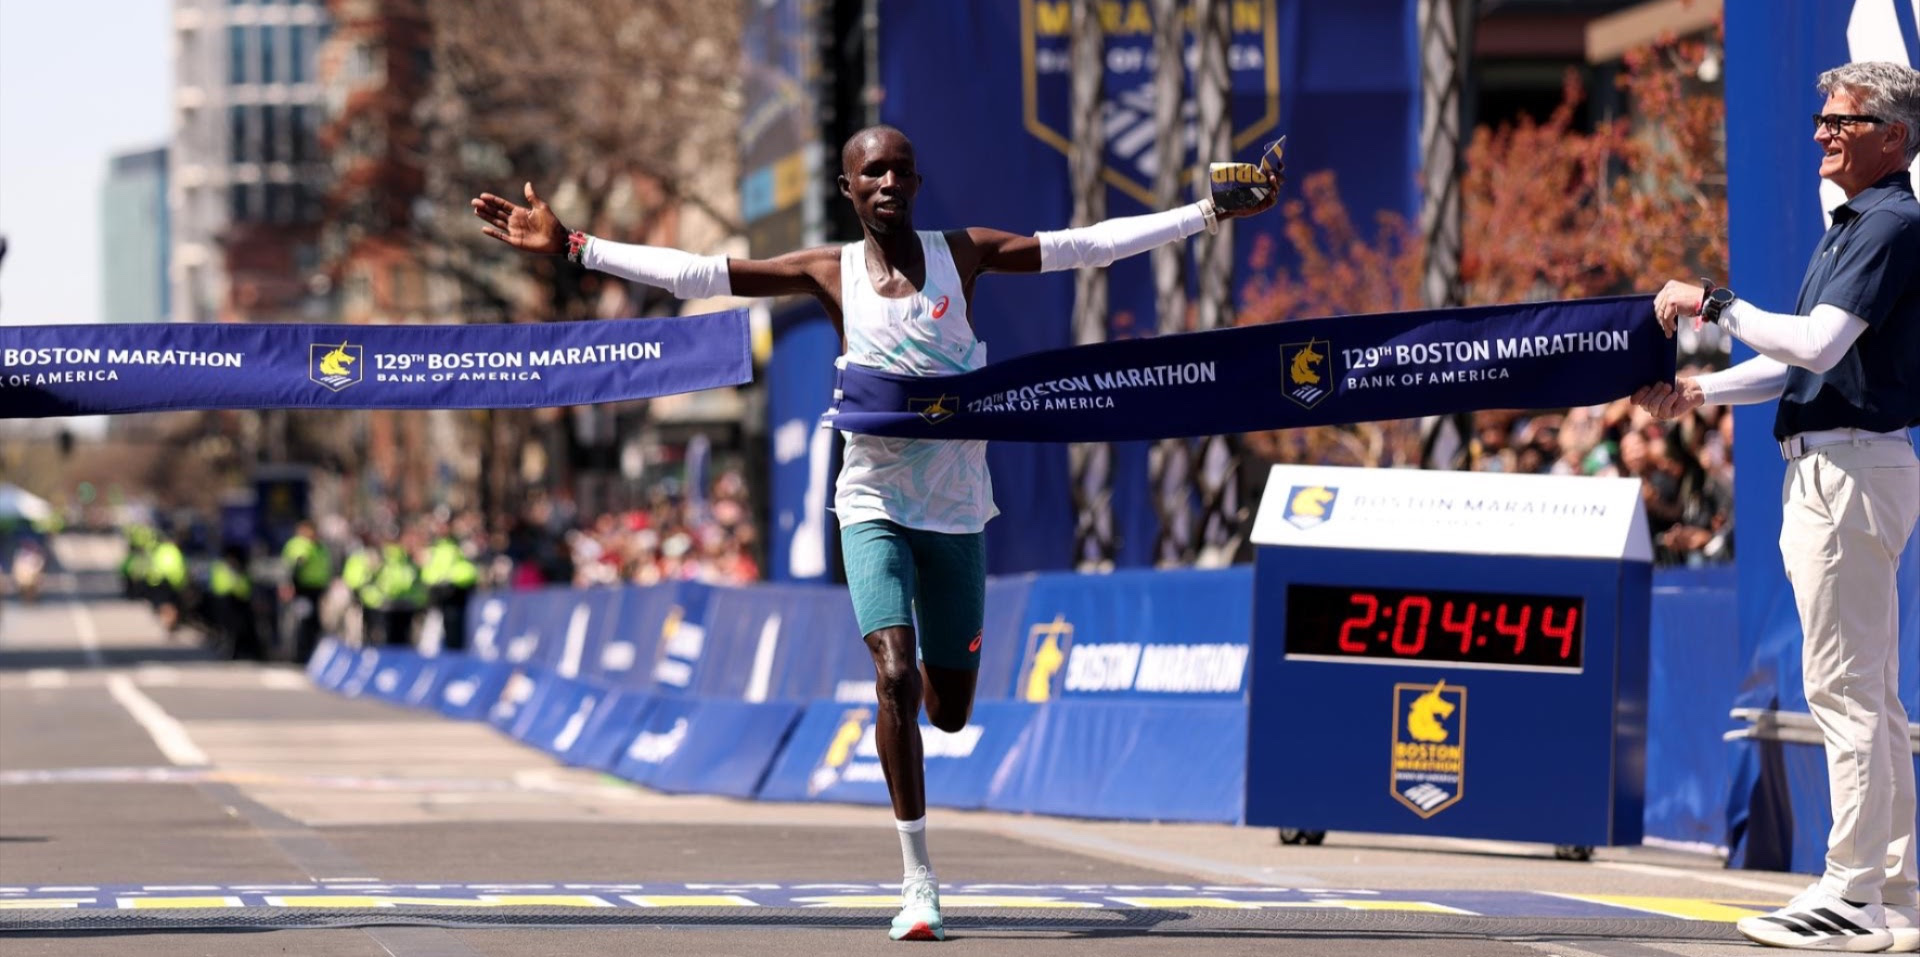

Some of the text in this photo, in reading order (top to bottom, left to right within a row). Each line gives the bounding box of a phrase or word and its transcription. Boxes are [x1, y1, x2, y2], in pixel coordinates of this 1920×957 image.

[4, 347, 242, 368] BOSTON MARATHON
[374, 341, 661, 371] 129TH BOSTON MARATHON
[1342, 330, 1629, 370] 129TH BOSTON MARATHON
[9, 373, 31, 386] OF
[36, 369, 119, 385] AMERICA
[376, 371, 542, 383] BANK OF AMERICA
[1094, 361, 1216, 390] MARATHON
[1347, 367, 1510, 391] BANK OF AMERICA
[1020, 399, 1041, 412] OF
[1045, 396, 1115, 411] AMERICA
[1339, 593, 1577, 659] 2:04:44
[1395, 743, 1460, 761] BOSTON
